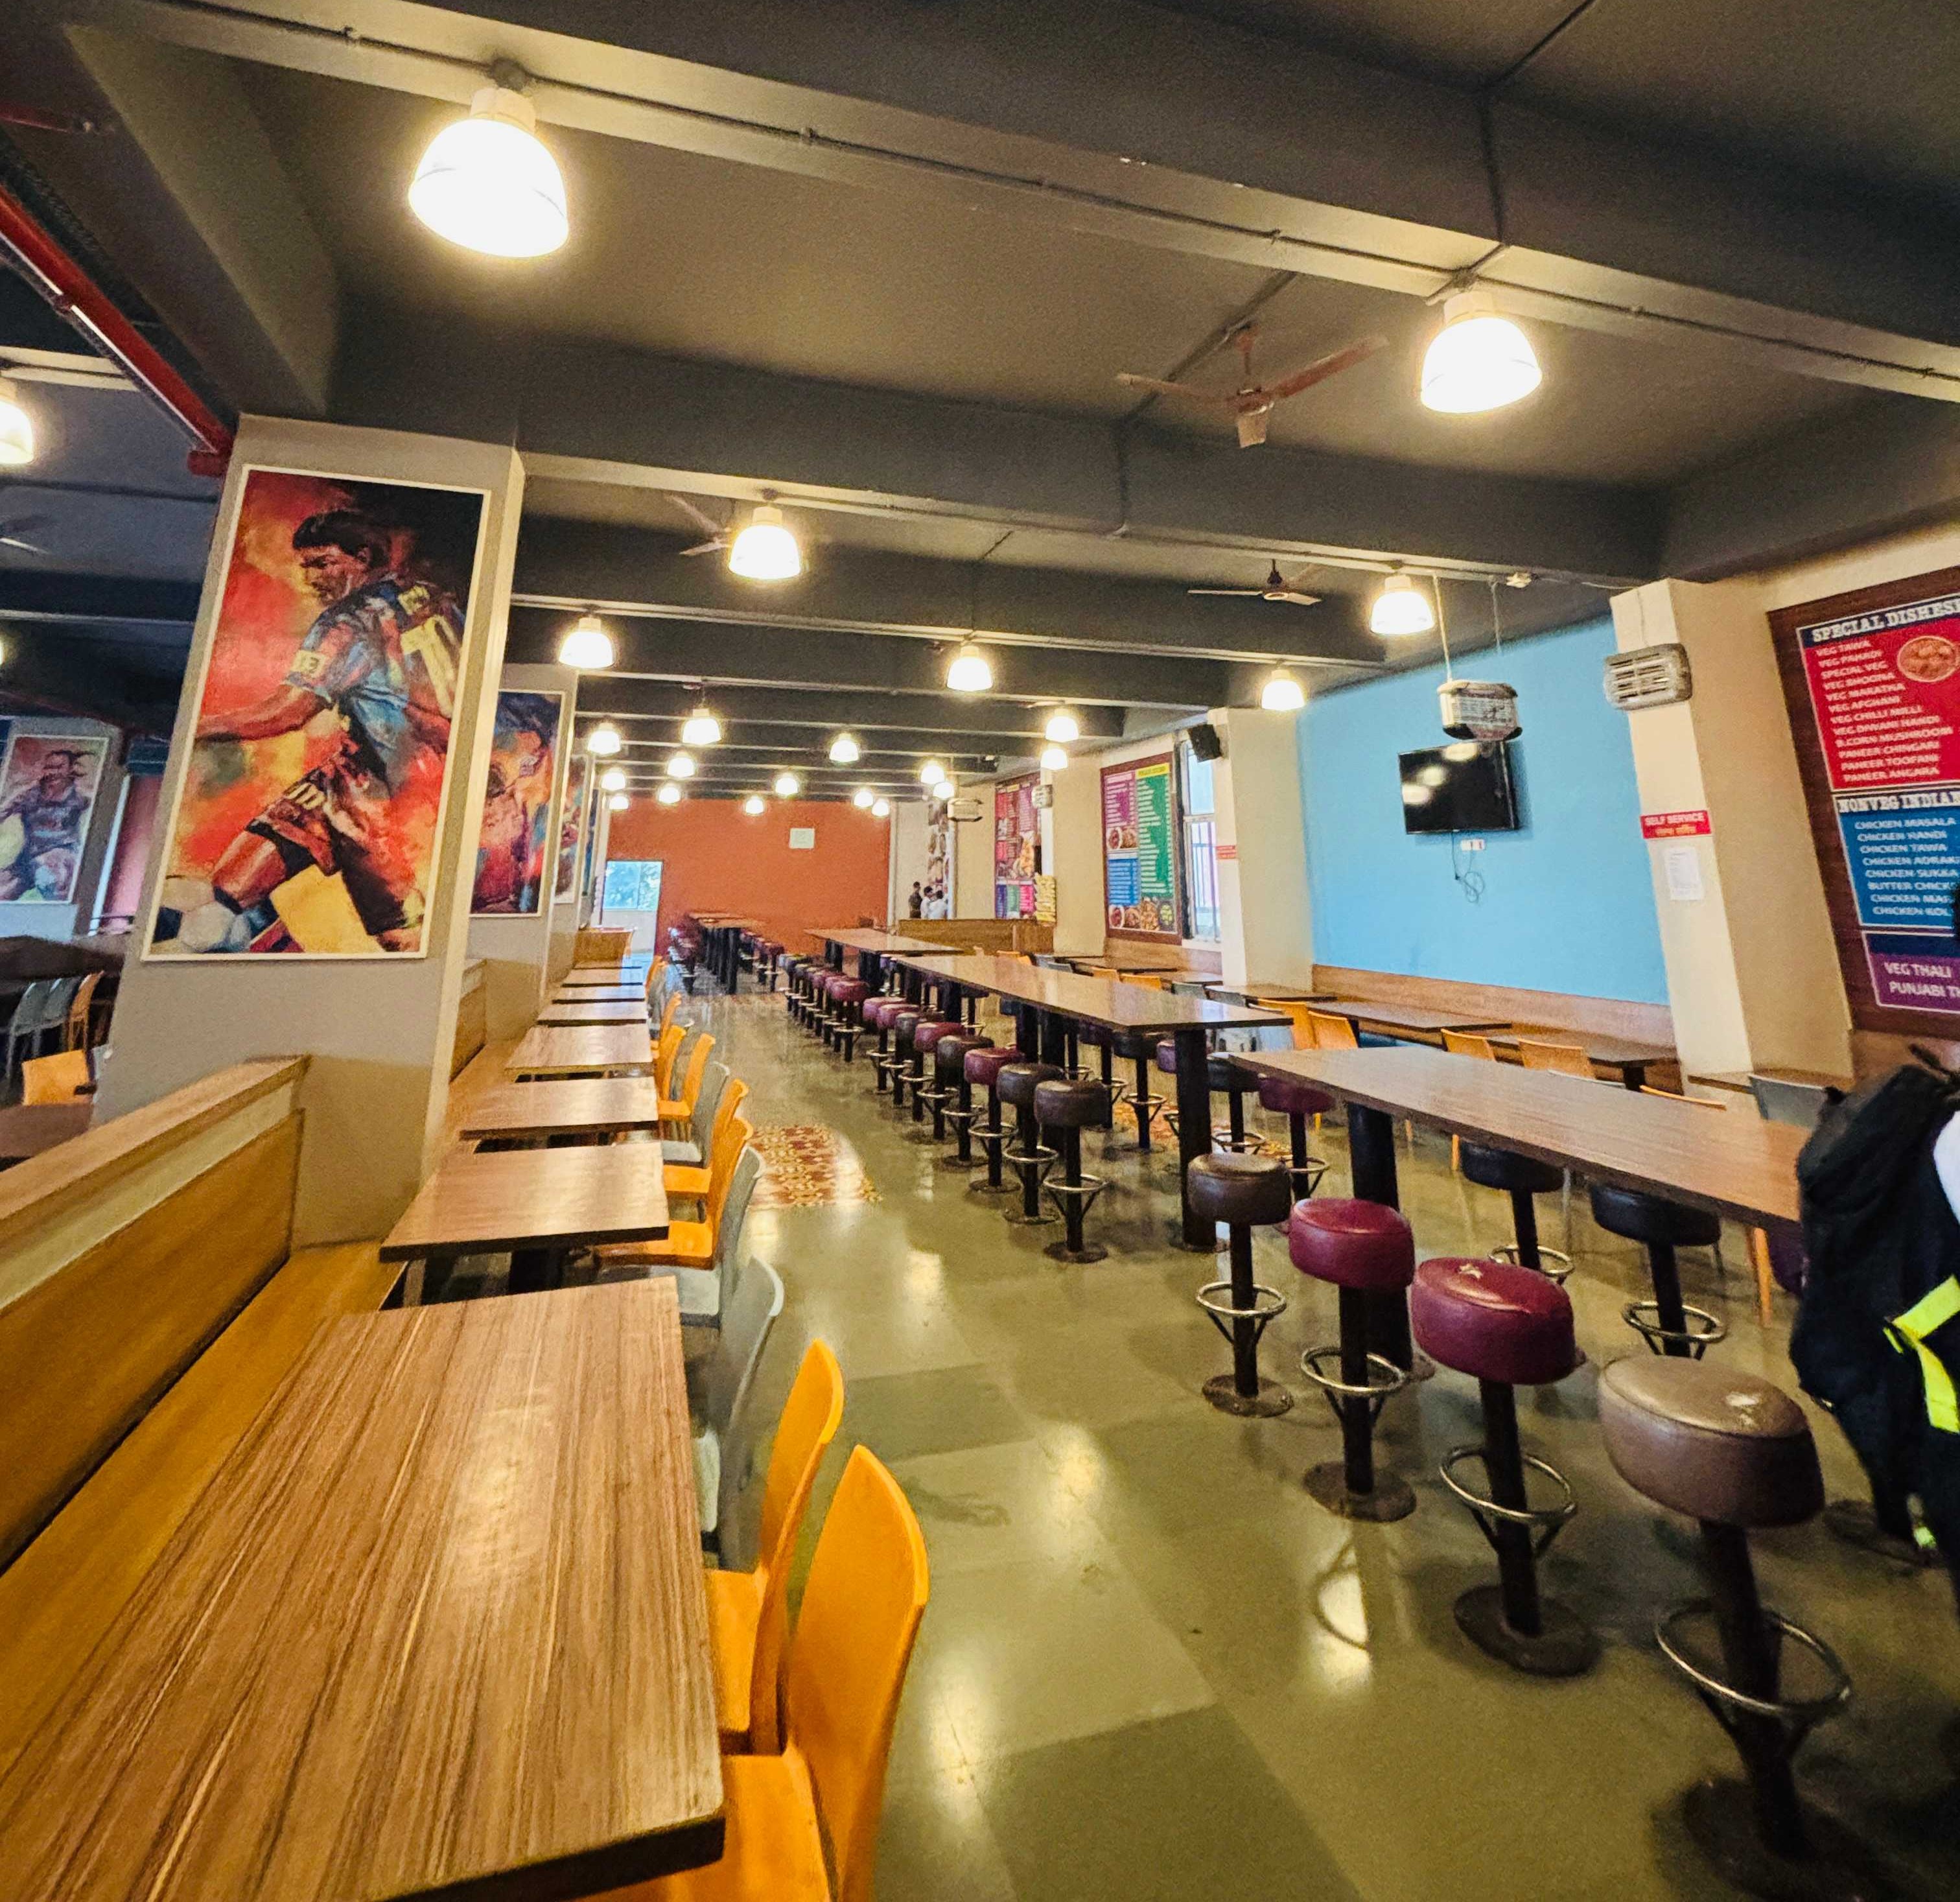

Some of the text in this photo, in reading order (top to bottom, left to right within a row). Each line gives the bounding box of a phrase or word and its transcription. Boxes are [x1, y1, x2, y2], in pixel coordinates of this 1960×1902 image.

[1812, 615, 1885, 642] SPECIAL
[1815, 647, 1837, 656] VEG
[1818, 658, 1840, 668] VEG
[1821, 661, 1888, 679] SPECIAL VEG
[1824, 681, 1845, 690] VEG
[1825, 692, 1847, 701] VEG
[1828, 703, 1850, 713] VEG
[1830, 714, 1852, 724] VEG
[1833, 726, 1856, 735] VEG
[1879, 727, 1954, 742] MUSHROOM
[1838, 747, 1880, 758] PANEER
[1841, 759, 1885, 770] PANEER
[1843, 771, 1888, 782] PANEER
[1645, 812, 1705, 826] SELF SERVICE
[1854, 819, 1902, 829] CHICKEN
[1857, 832, 1906, 841] CHICKEN
[1860, 845, 1908, 854] CHICKEN
[1862, 856, 1912, 865] CHICKEN
[1865, 869, 1914, 878] CHICKEN
[1867, 882, 1913, 890] BUTTER
[1871, 894, 1920, 902] CHICKEN
[1872, 906, 1924, 915] CHICKEN
[1884, 962, 1951, 978] VEG THALI
[1889, 981, 1946, 996] PUNJABI
